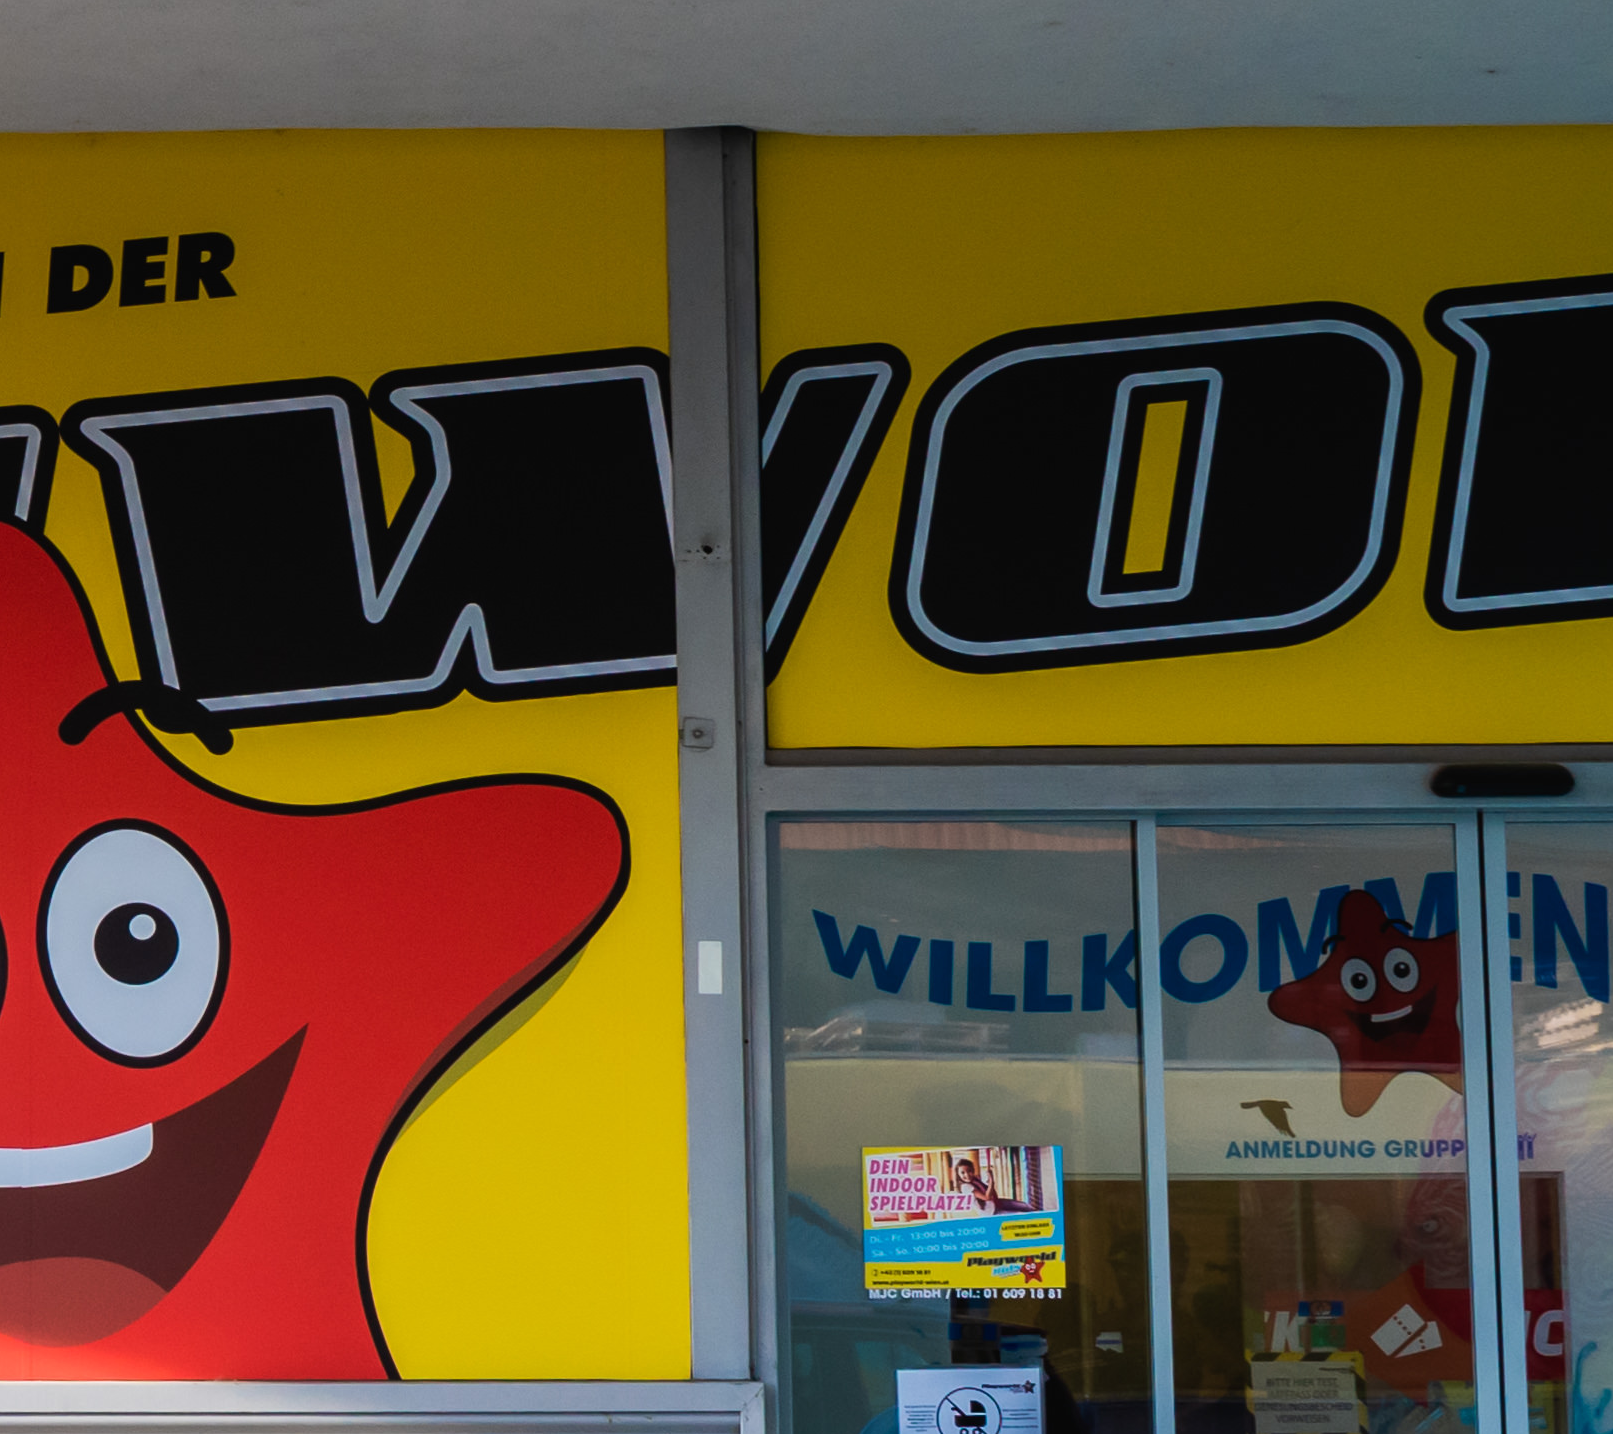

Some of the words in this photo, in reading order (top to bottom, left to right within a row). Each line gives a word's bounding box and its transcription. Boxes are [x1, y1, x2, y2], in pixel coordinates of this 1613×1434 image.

[44, 230, 239, 315] DER
[1225, 1138, 1376, 1159] ANMELDUNG
[1383, 1138, 1466, 1159] GRUPP
[869, 1159, 910, 1175] DEIN
[870, 1177, 937, 1193] INDOOR
[870, 1194, 973, 1211] SPIELPLATZ!
[869, 1289, 897, 1299] MJC
[901, 1288, 941, 1299] GmbH
[945, 1289, 951, 1300] /
[956, 1288, 981, 1299] Tel.:
[983, 1288, 998, 1299] 01
[1002, 1288, 1026, 1299] 609
[1030, 1288, 1045, 1299] 18
[1047, 1288, 1063, 1299] 81
